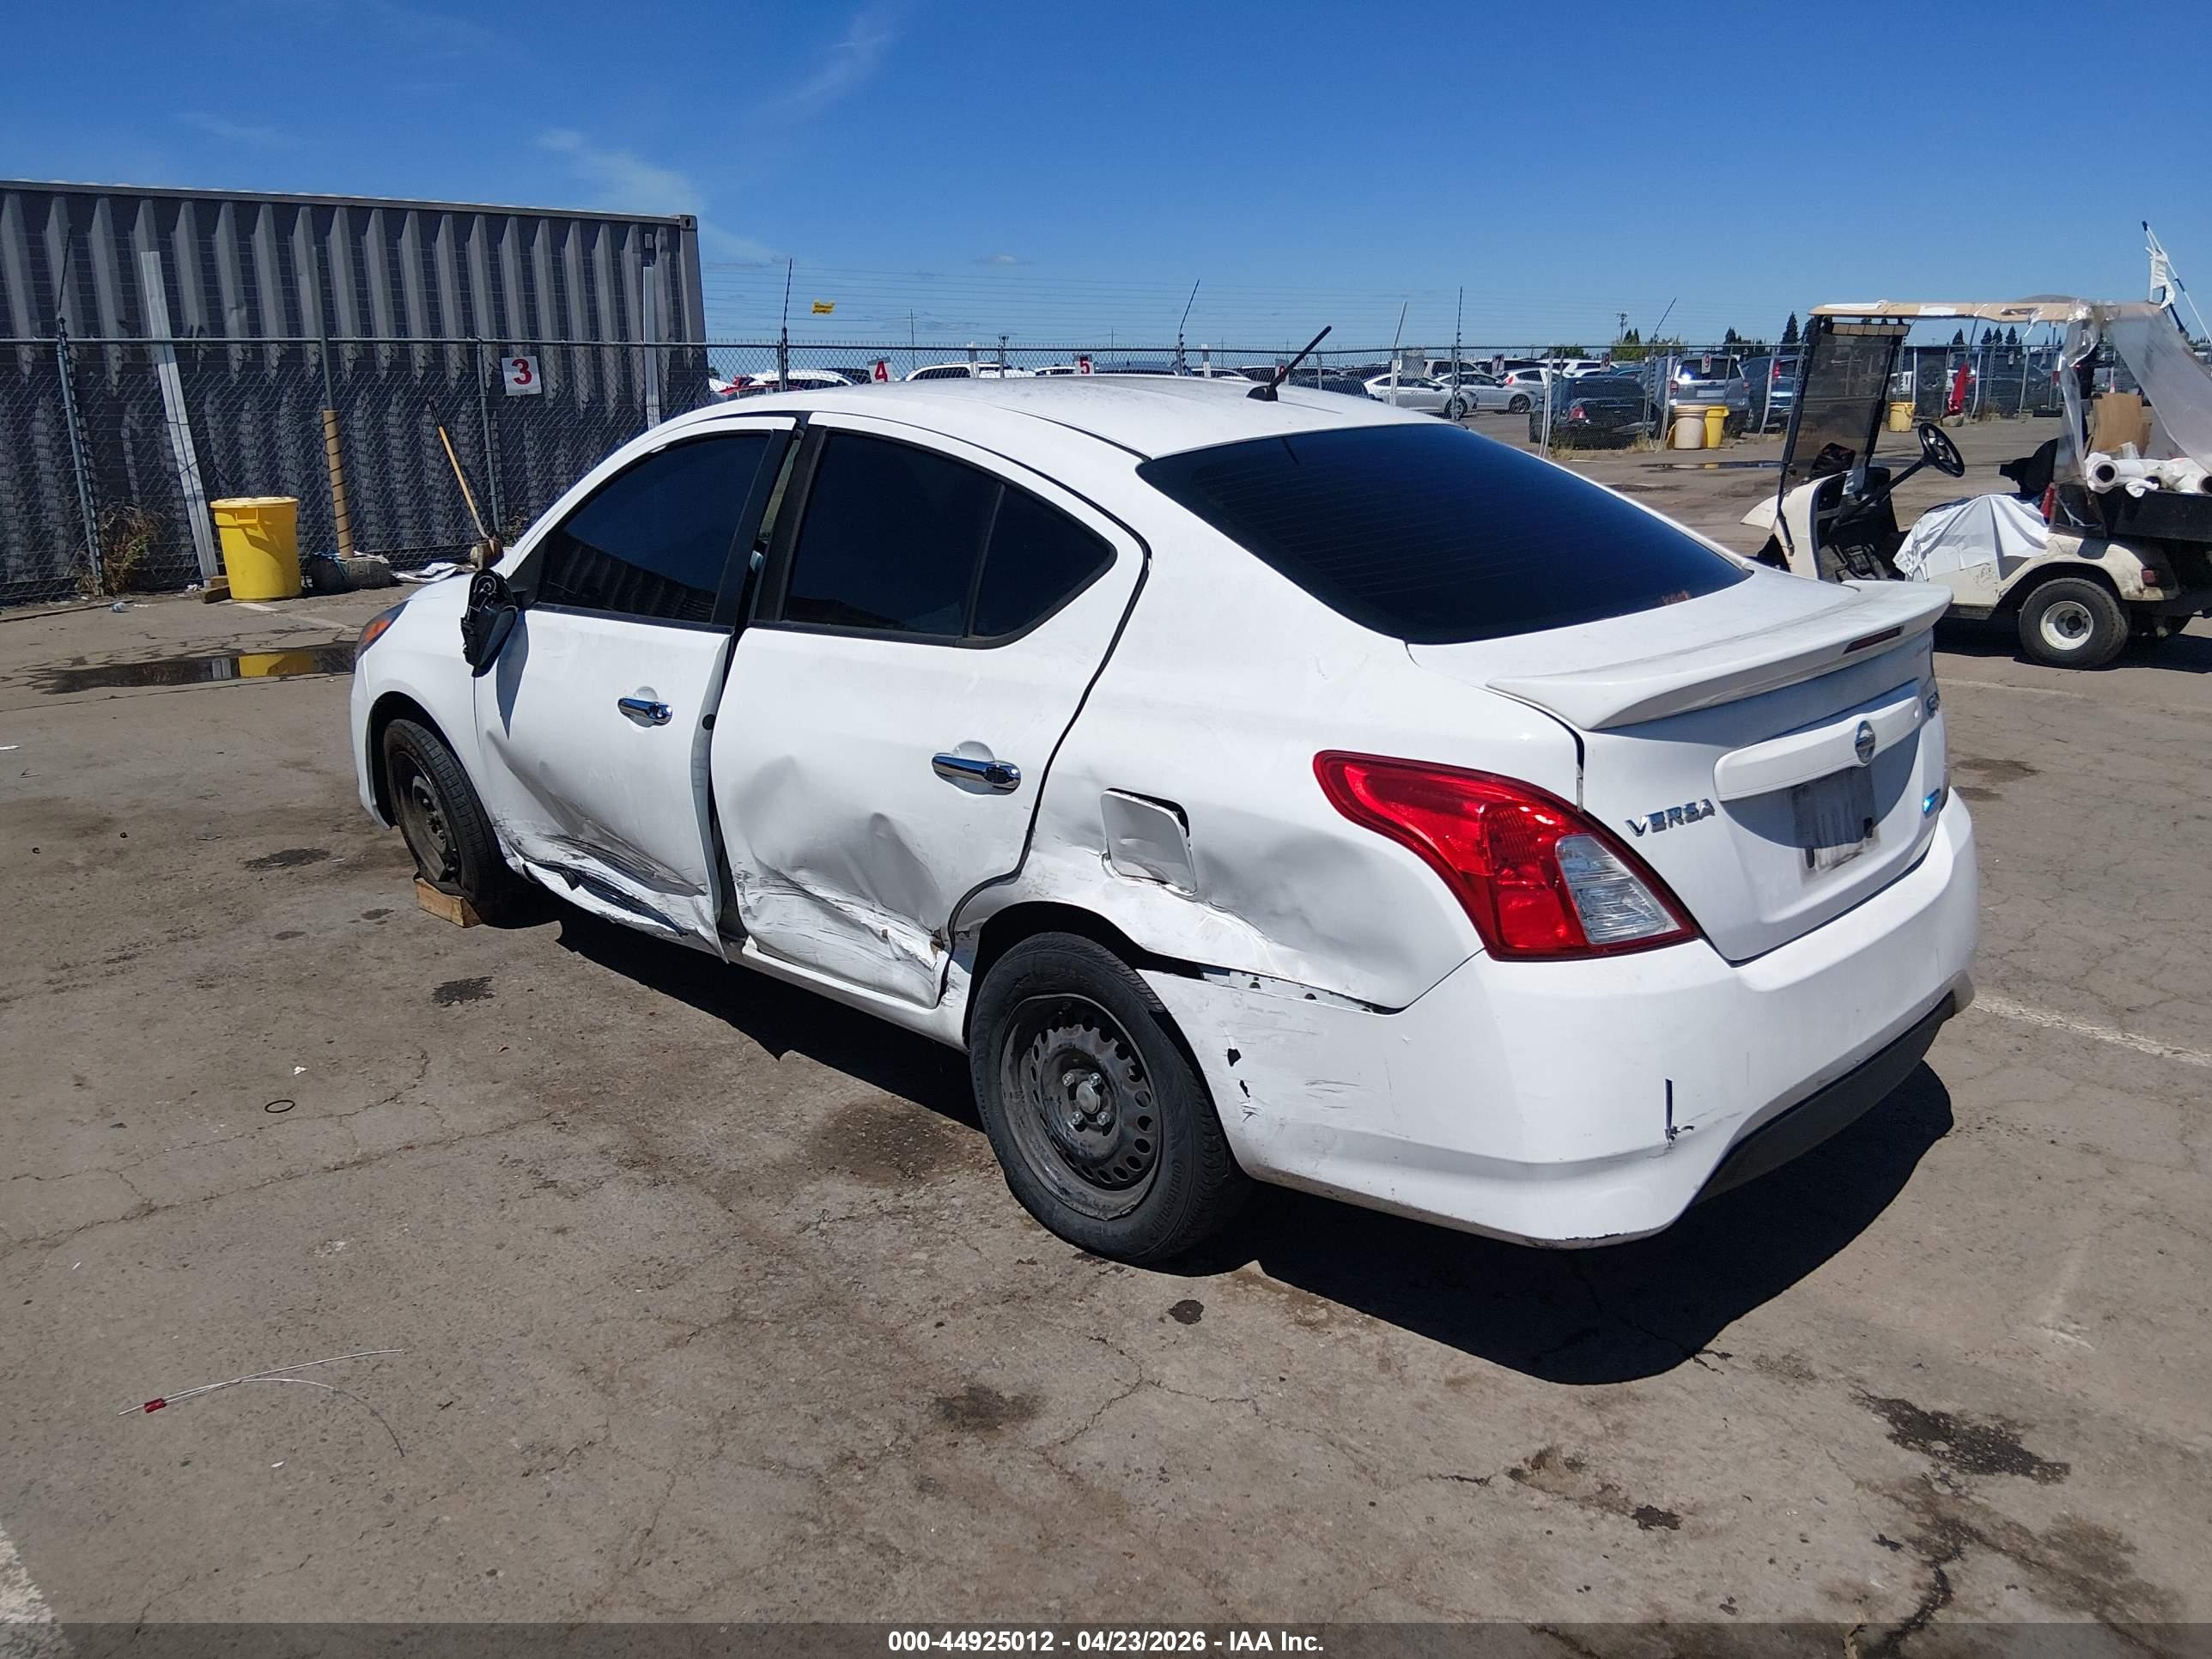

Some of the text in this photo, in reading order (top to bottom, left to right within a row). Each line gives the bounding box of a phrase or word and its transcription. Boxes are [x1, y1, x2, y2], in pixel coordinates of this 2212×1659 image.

[511, 358, 532, 386] 3
[873, 360, 889, 383] 4
[1079, 356, 1091, 375] 5
[1495, 355, 1503, 372] 7
[1624, 799, 1716, 838] VERSA
